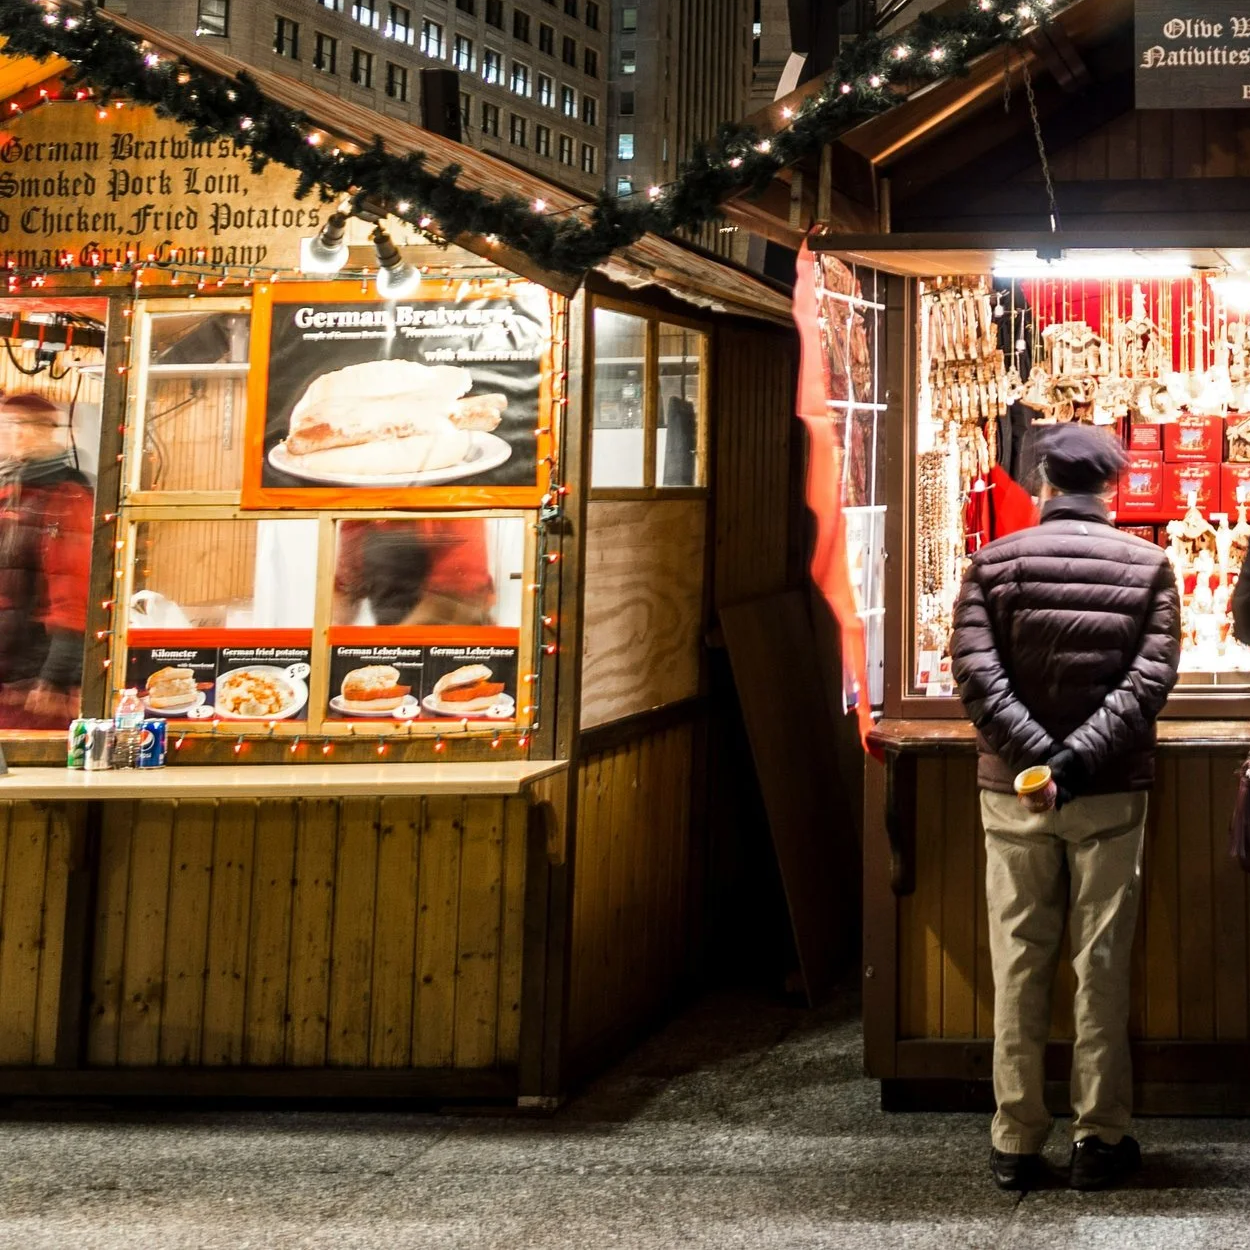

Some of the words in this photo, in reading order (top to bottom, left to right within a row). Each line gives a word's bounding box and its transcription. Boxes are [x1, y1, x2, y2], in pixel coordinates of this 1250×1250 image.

[1163, 18, 1223, 39] Olive
[1, 136, 99, 163] German
[0, 170, 96, 198] Smoked
[107, 168, 172, 201] Pork
[183, 167, 249, 196] Loin,
[21, 205, 123, 238] Chicken,
[126, 203, 198, 236] Fried
[208, 202, 320, 236] Potatoes
[81, 240, 141, 268] Grill
[154, 240, 267, 270] Company
[294, 307, 391, 329] German
[151, 648, 198, 658] Kilometer
[223, 648, 254, 656] German
[275, 648, 308, 657] potatoes
[337, 646, 372, 655] German
[430, 646, 465, 655] German
